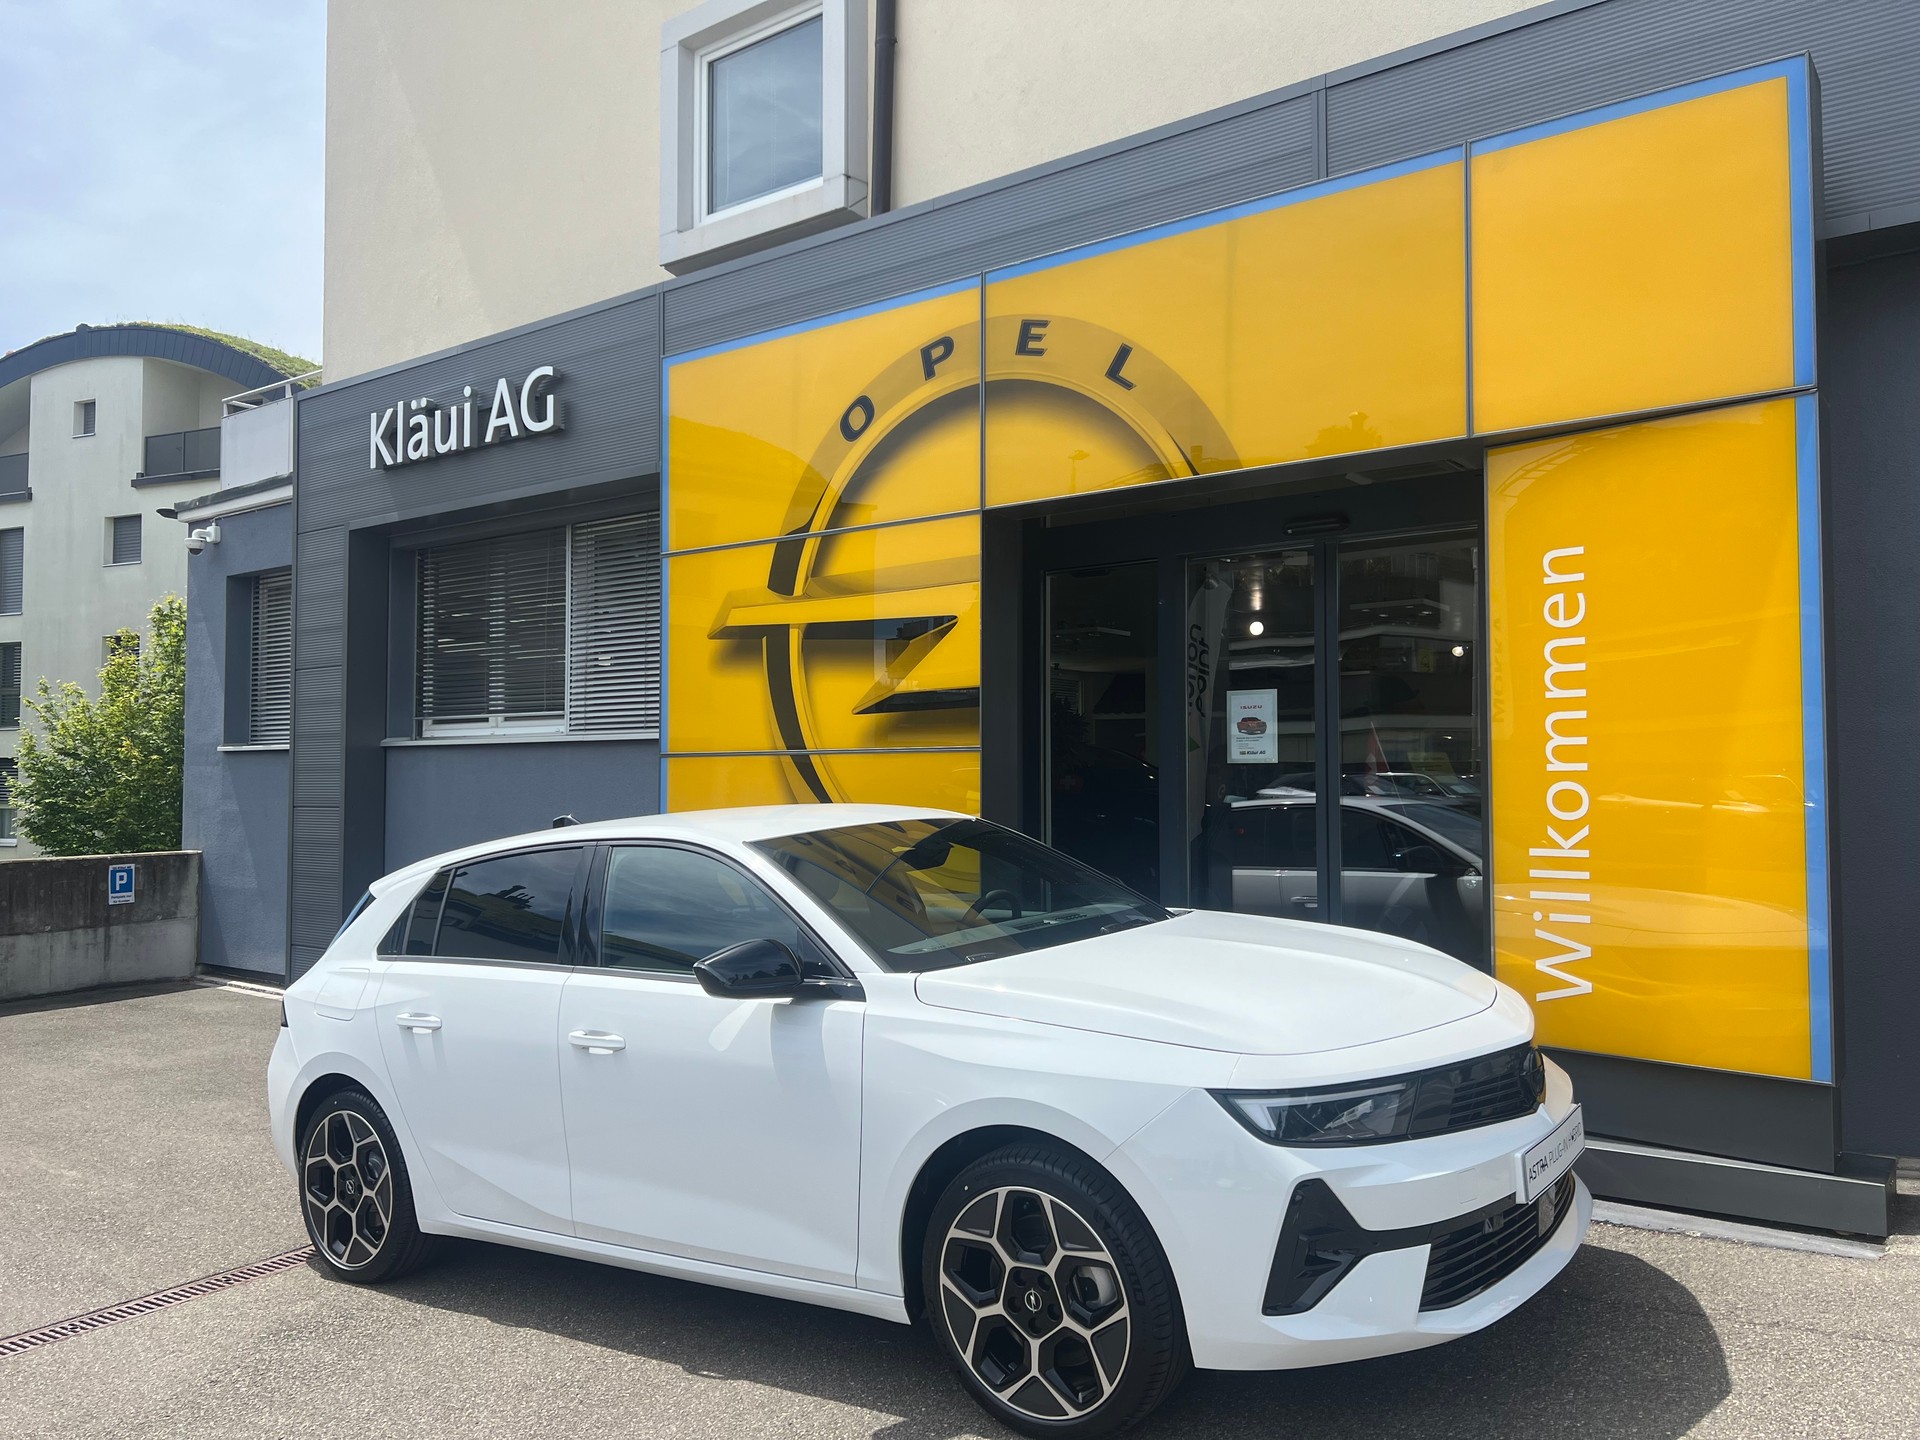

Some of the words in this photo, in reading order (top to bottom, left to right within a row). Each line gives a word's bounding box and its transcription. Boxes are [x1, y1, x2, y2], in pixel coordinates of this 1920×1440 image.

[370, 385, 476, 469] Kläui
[485, 366, 554, 443] AG
[840, 319, 1136, 442] OPEL
[1528, 544, 1593, 1002] Willkommen
[115, 871, 128, 891] P
[1528, 1156, 1549, 1184] ASTRA
[1549, 1137, 1569, 1167] PLUG-IN
